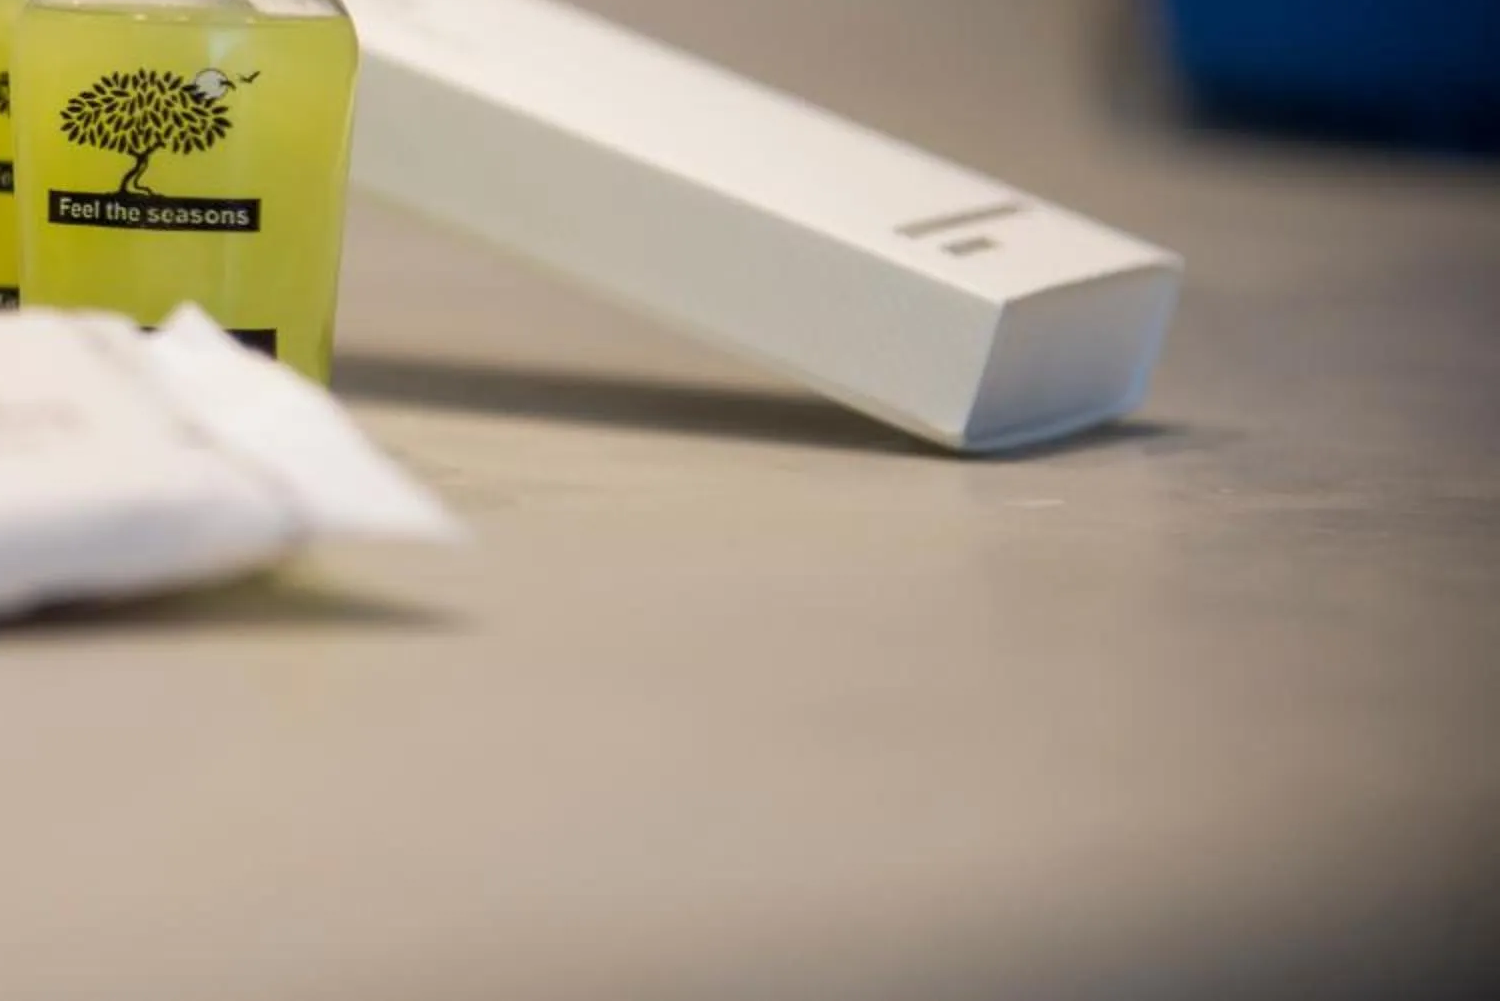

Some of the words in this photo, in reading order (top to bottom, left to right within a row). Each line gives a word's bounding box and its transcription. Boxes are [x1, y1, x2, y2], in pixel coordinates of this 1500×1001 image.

[59, 198, 100, 218] Feel
[105, 202, 141, 221] the
[147, 206, 250, 225] seasons
